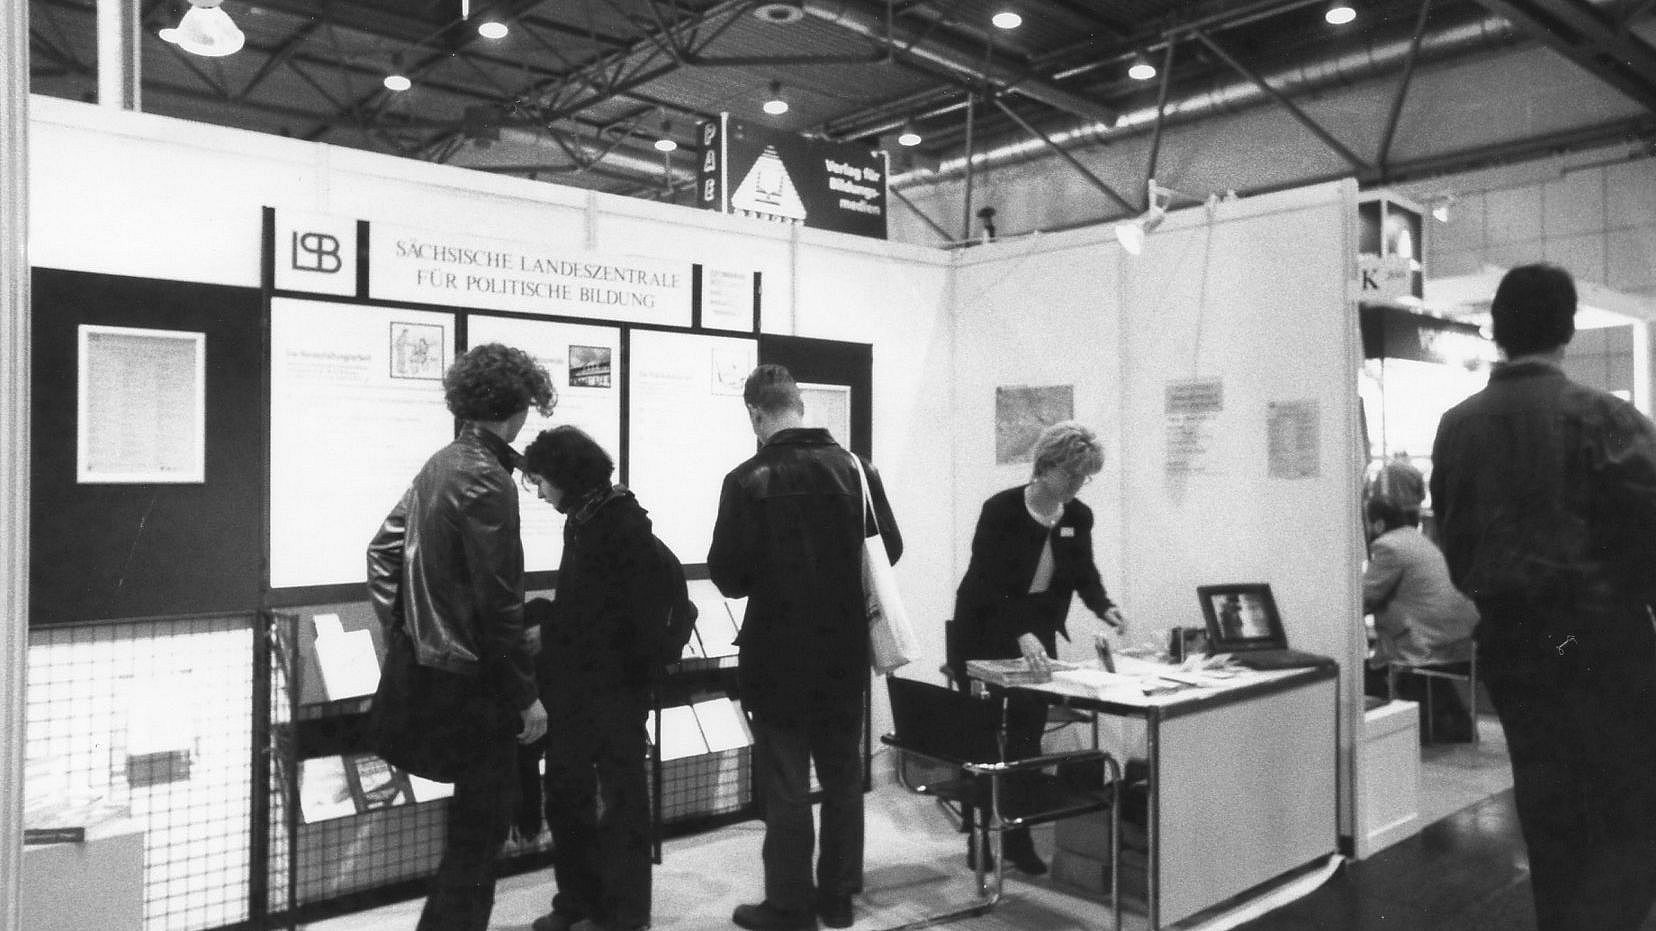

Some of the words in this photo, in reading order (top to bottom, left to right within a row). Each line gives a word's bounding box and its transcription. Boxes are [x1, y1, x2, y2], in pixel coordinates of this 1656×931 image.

[396, 239, 514, 271] SÄCHSISCHE
[520, 257, 681, 289] LANDESZENTRALE
[416, 268, 456, 289] FÜR
[466, 275, 572, 300] POLITISCHE
[580, 287, 656, 309] BILDUNG
